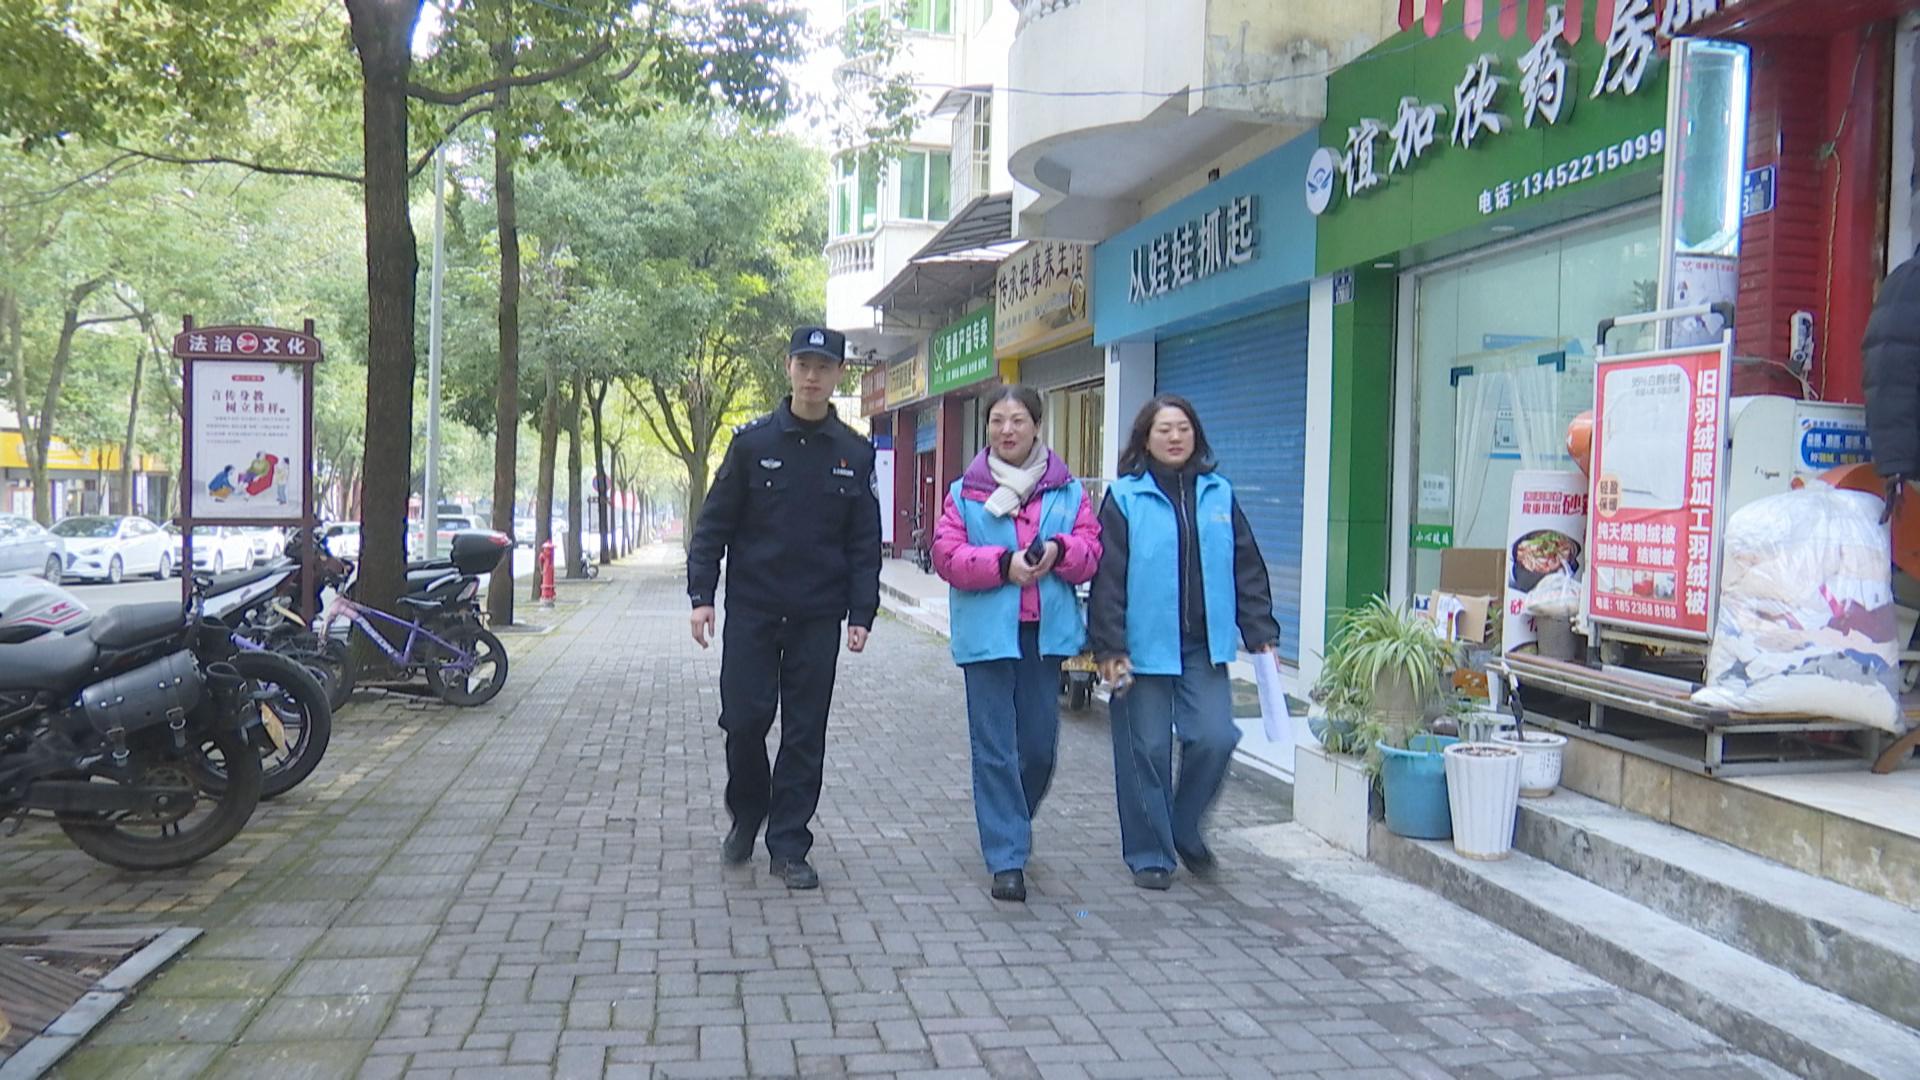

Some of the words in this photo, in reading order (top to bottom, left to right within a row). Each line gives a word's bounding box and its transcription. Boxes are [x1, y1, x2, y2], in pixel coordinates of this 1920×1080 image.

[1340, 0, 1659, 199] 谊加欣药房
[998, 241, 1084, 313] 传承按摩养生馆
[1128, 194, 1255, 304] 从娃娃抓起
[189, 334, 306, 355] 法治文化
[1685, 369, 1718, 617] 旧羽绒服加工羽绒被
